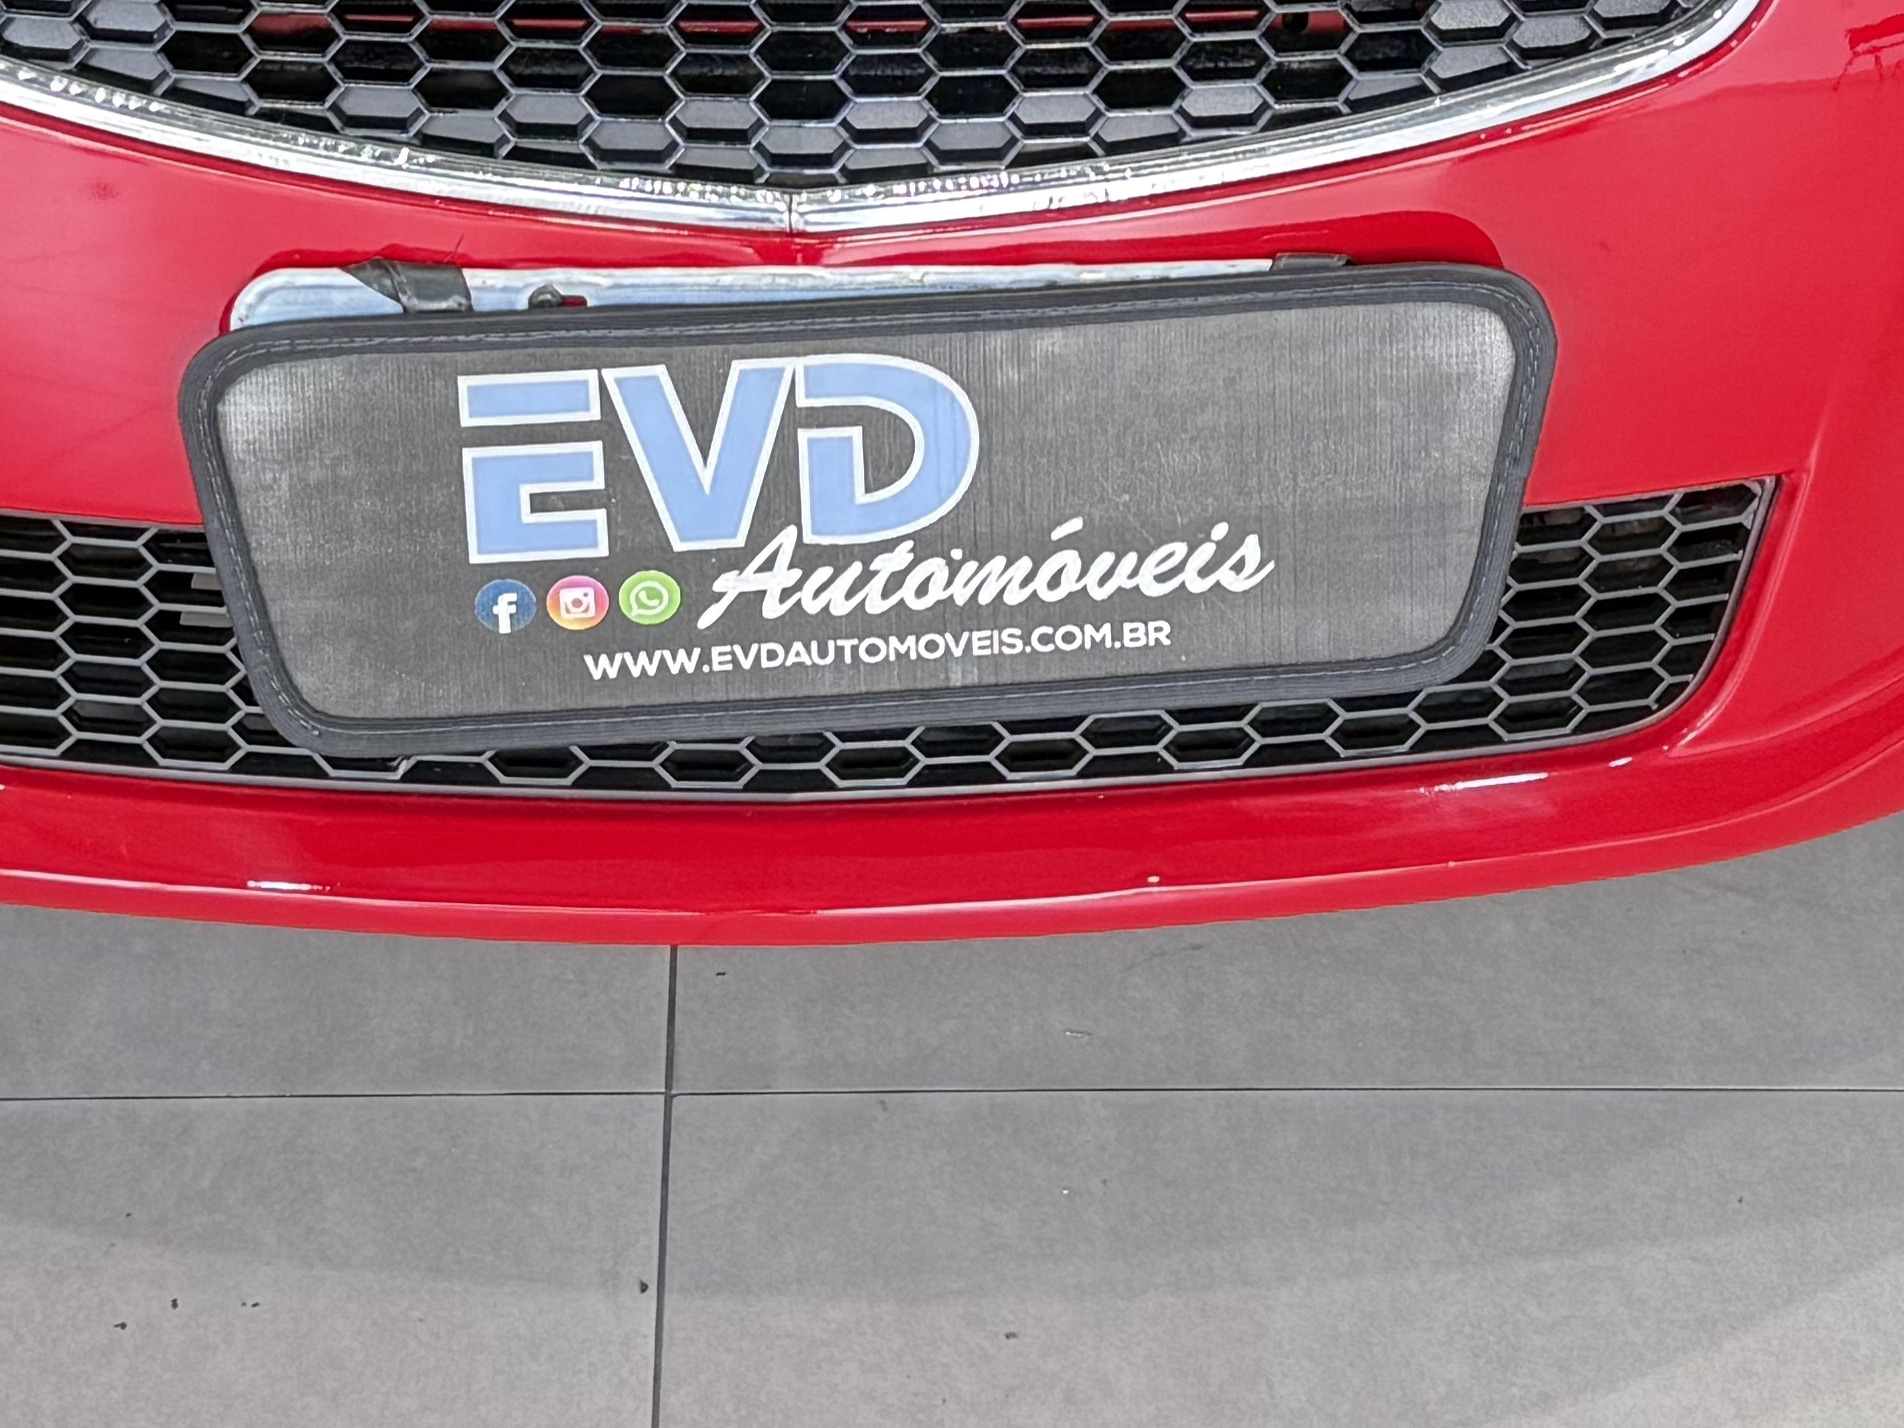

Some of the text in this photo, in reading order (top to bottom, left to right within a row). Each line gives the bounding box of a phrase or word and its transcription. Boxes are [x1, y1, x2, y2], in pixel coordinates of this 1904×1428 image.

[458, 352, 980, 565] EVD
[696, 516, 1276, 630] Automóveis
[583, 620, 1172, 681] WWW.EVDAUTOMOVEIS.COM.BR
